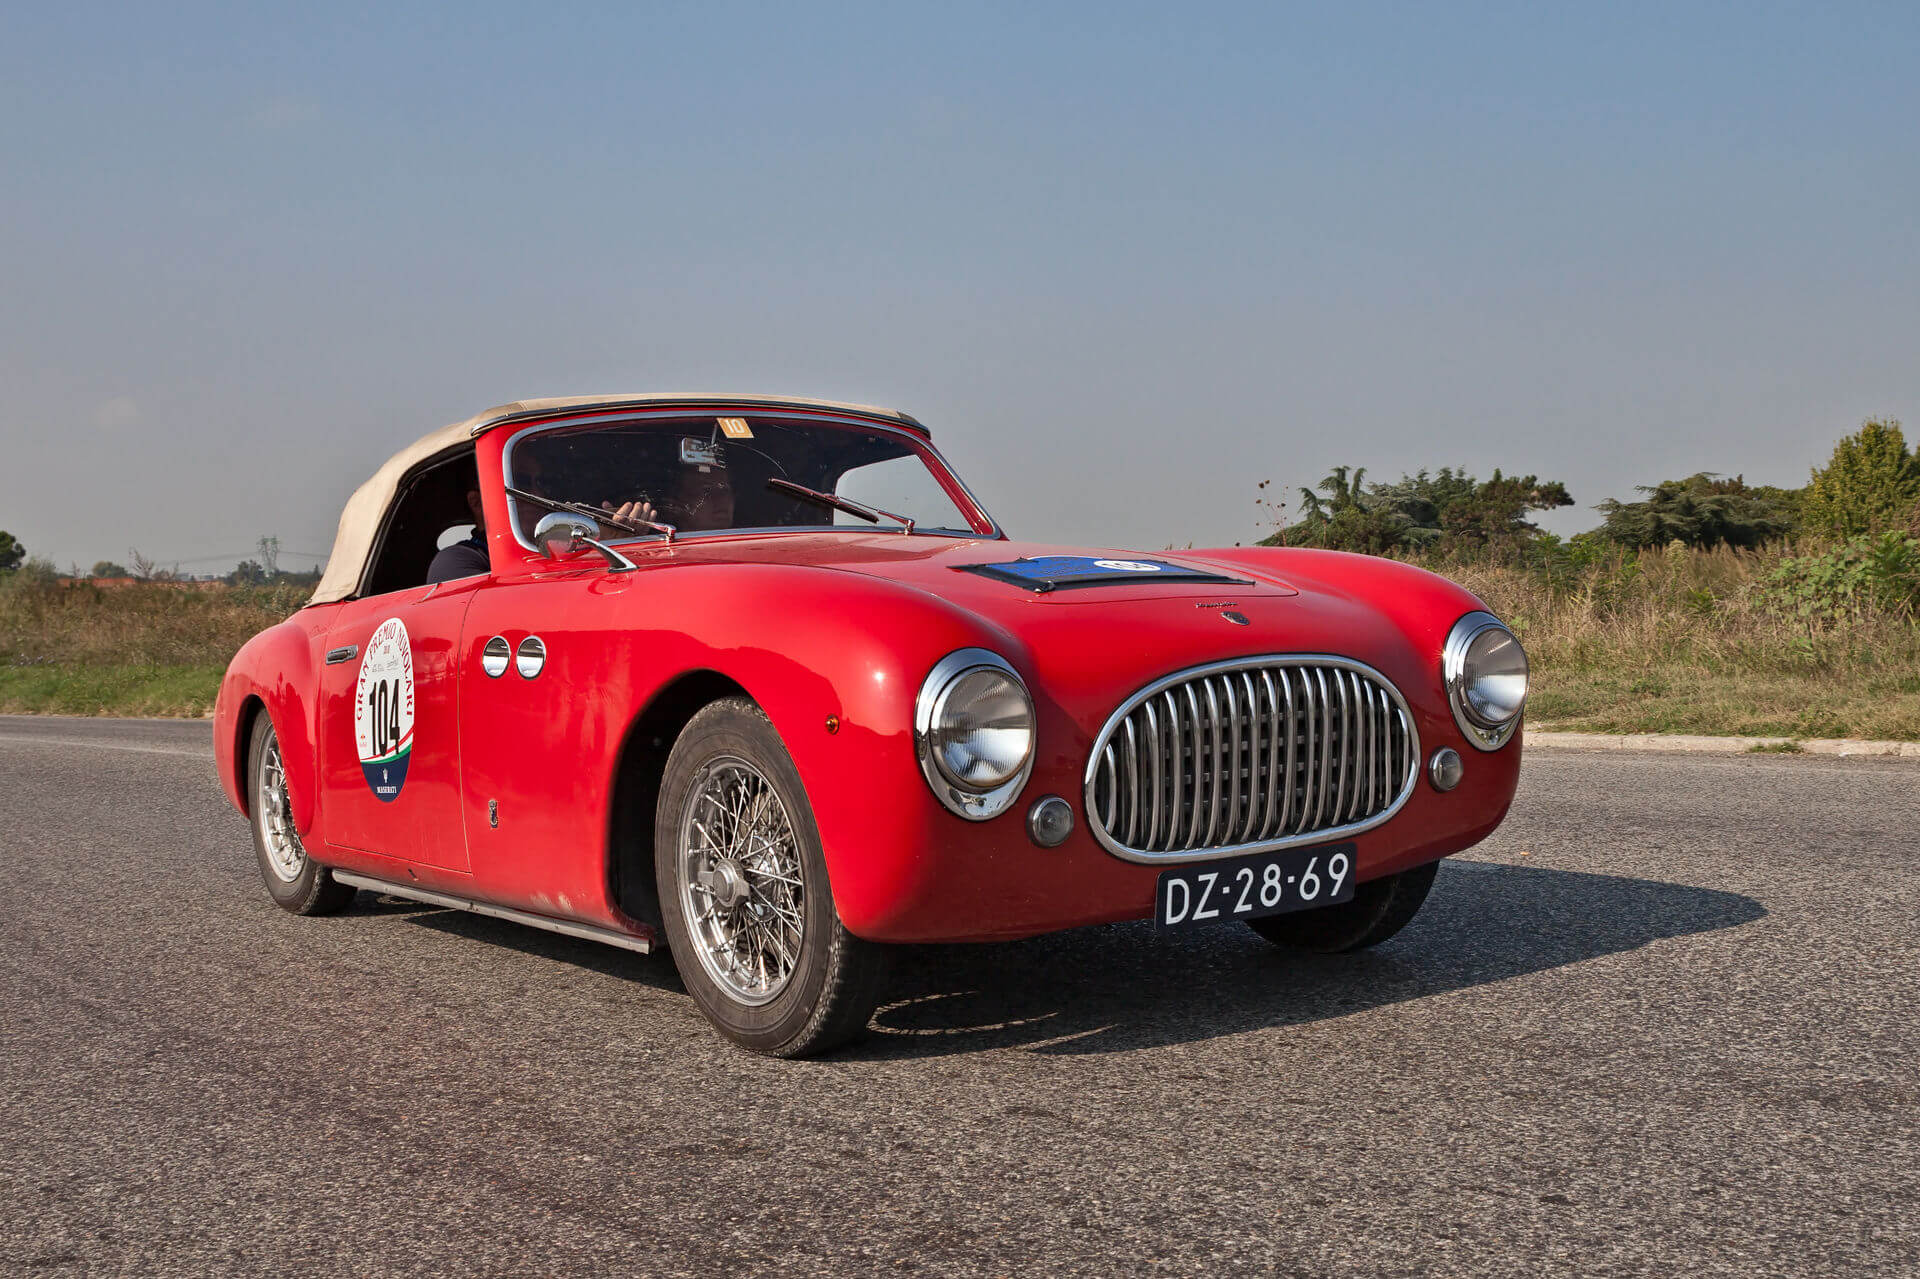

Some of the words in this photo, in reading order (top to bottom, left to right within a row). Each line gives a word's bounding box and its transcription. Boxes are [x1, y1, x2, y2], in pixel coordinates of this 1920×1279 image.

[725, 419, 745, 433] 10
[357, 660, 370, 720] GRAN
[369, 622, 397, 661] PREMIO
[395, 626, 413, 716] NUVOLARI
[369, 679, 400, 757] 104
